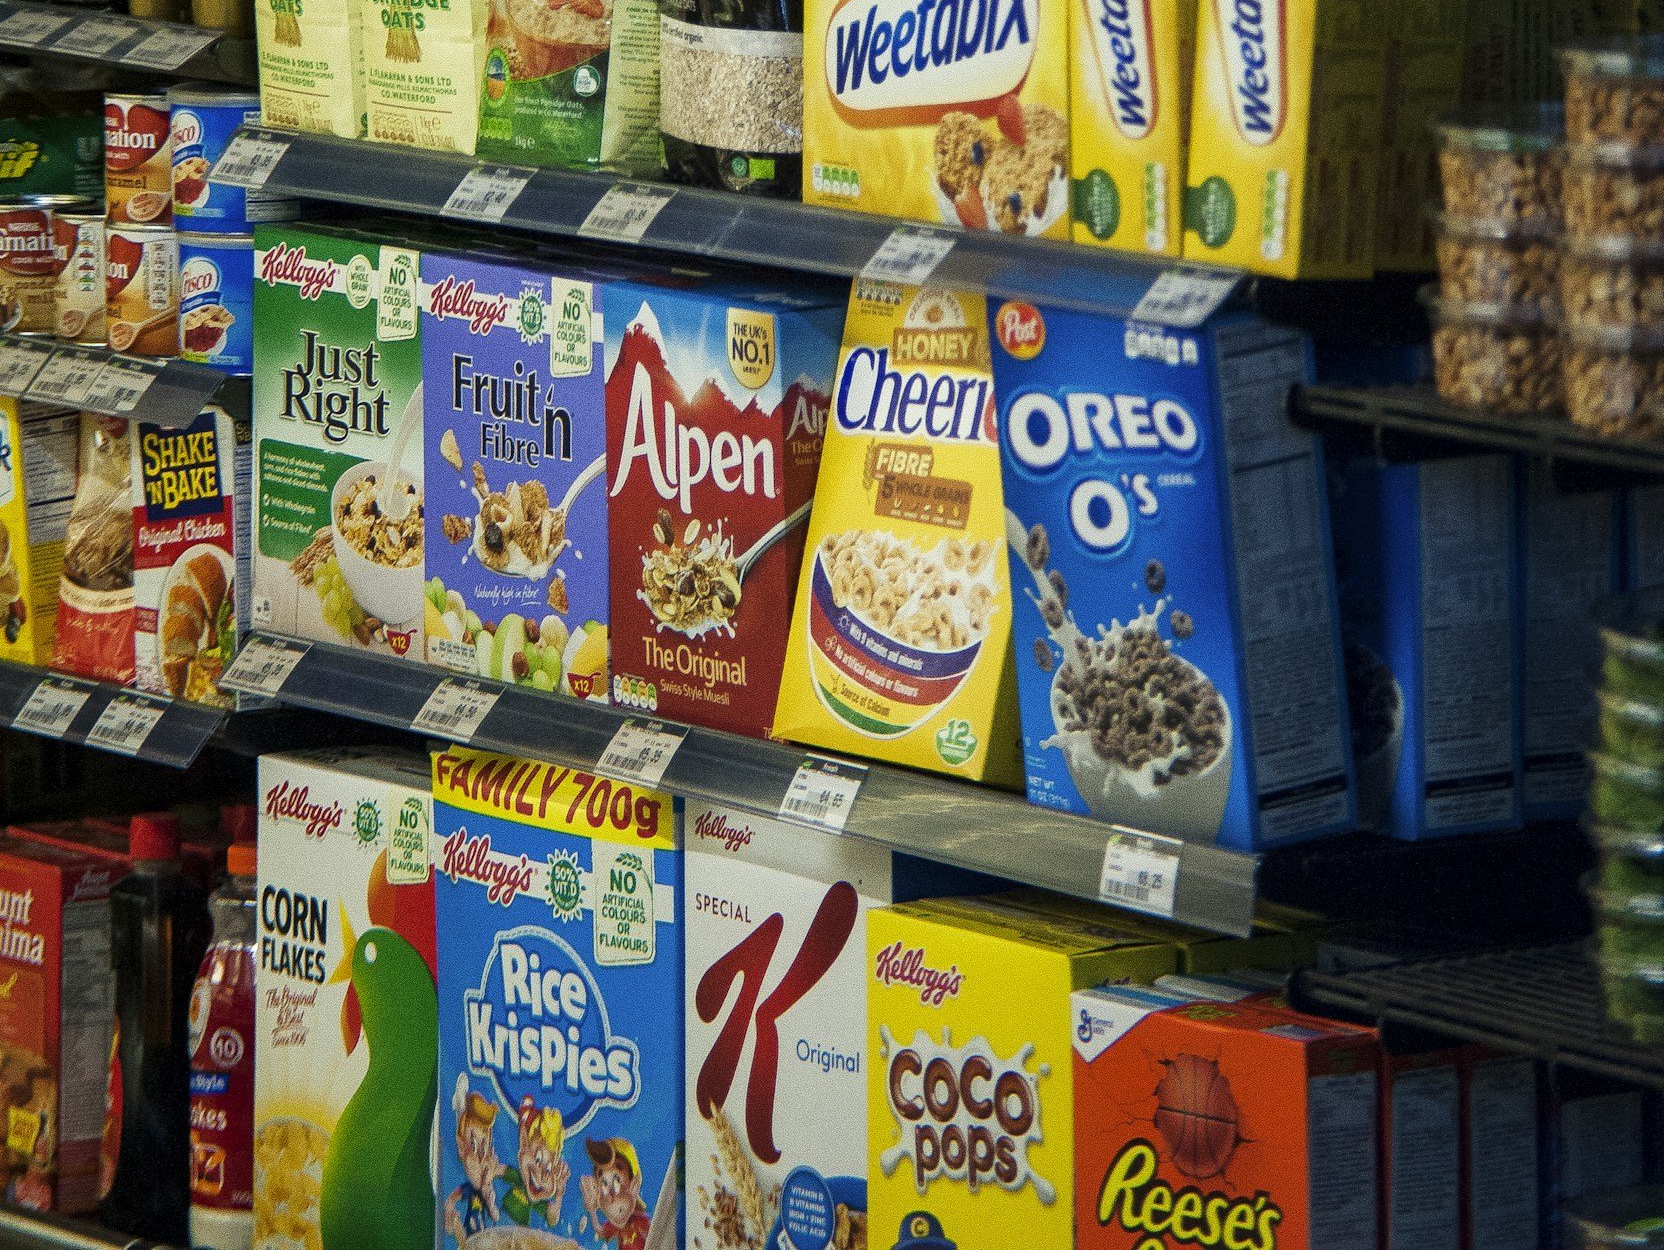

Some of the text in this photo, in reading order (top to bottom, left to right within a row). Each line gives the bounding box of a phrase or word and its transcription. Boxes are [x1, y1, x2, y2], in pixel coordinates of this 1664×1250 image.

[381, 7, 427, 33] OATS
[314, 61, 329, 72] LTD
[415, 74, 452, 87] SONS LTD
[262, 243, 337, 300] Kellogg's
[350, 272, 370, 283] WHOLE
[389, 266, 407, 286] NO
[351, 281, 369, 293] GRAIN
[383, 285, 412, 299] ARTIFICIAL
[383, 295, 412, 309] COLOURS
[391, 307, 402, 318] OR
[430, 279, 508, 334] Kellogg's
[562, 301, 581, 320] NO
[380, 316, 413, 331] FLAVOURS
[556, 331, 587, 344] COLOURS
[557, 321, 586, 333] ARTIFICIAL
[733, 322, 748, 337] THE
[1004, 309, 1037, 344] Post
[297, 330, 380, 387] Just
[554, 352, 588, 367] FLAVOURS
[566, 343, 576, 353] OR
[731, 337, 771, 366] NO.1
[898, 332, 973, 361] HONEY
[280, 367, 391, 441] Right
[453, 355, 541, 426] Fruit
[481, 424, 540, 465] Fibre
[610, 362, 779, 514] Alpen
[1008, 392, 1199, 469] OREO
[142, 430, 217, 476] SHAKE
[876, 448, 932, 478] FIBRE
[161, 465, 219, 510] BAKE
[880, 474, 897, 501] 5
[896, 481, 930, 498] WHOLE
[1071, 475, 1158, 549] O'S
[138, 516, 227, 554] Original Chicken
[642, 636, 748, 687] The Original
[660, 679, 731, 706] Swiss Style Muesli
[840, 682, 861, 701] Source
[867, 695, 891, 718] Calcium
[266, 780, 344, 838] Kellogg's
[436, 753, 661, 839] FAMILY 700g
[399, 808, 419, 829] NO
[695, 811, 754, 850] Kellogg's
[392, 838, 424, 853] COLOURS
[393, 828, 424, 840] ARTIFICIAL
[390, 858, 426, 875] FLAVOURS
[402, 850, 413, 861] OR
[442, 829, 534, 904] Kellogg's
[554, 866, 576, 881] 50%
[609, 868, 637, 895] NO
[262, 884, 328, 946] CORN
[602, 893, 645, 910] ARTIFICIAL
[602, 905, 646, 924] COLOURS
[695, 893, 752, 923] SPECIAL
[617, 922, 630, 936] OR
[599, 935, 648, 954] FLAVOURS
[262, 934, 326, 985] FLAKES
[876, 941, 964, 1003] Kellogg's
[501, 943, 588, 1019] Rice
[696, 881, 858, 1165] K
[470, 1000, 633, 1098] Krispies
[796, 1039, 861, 1074] Original
[915, 1124, 1019, 1186] pops
[791, 1186, 818, 1200] VITAMIN
[796, 1198, 827, 1214] VITAMINS
[1099, 1143, 1281, 1250] Reese's
